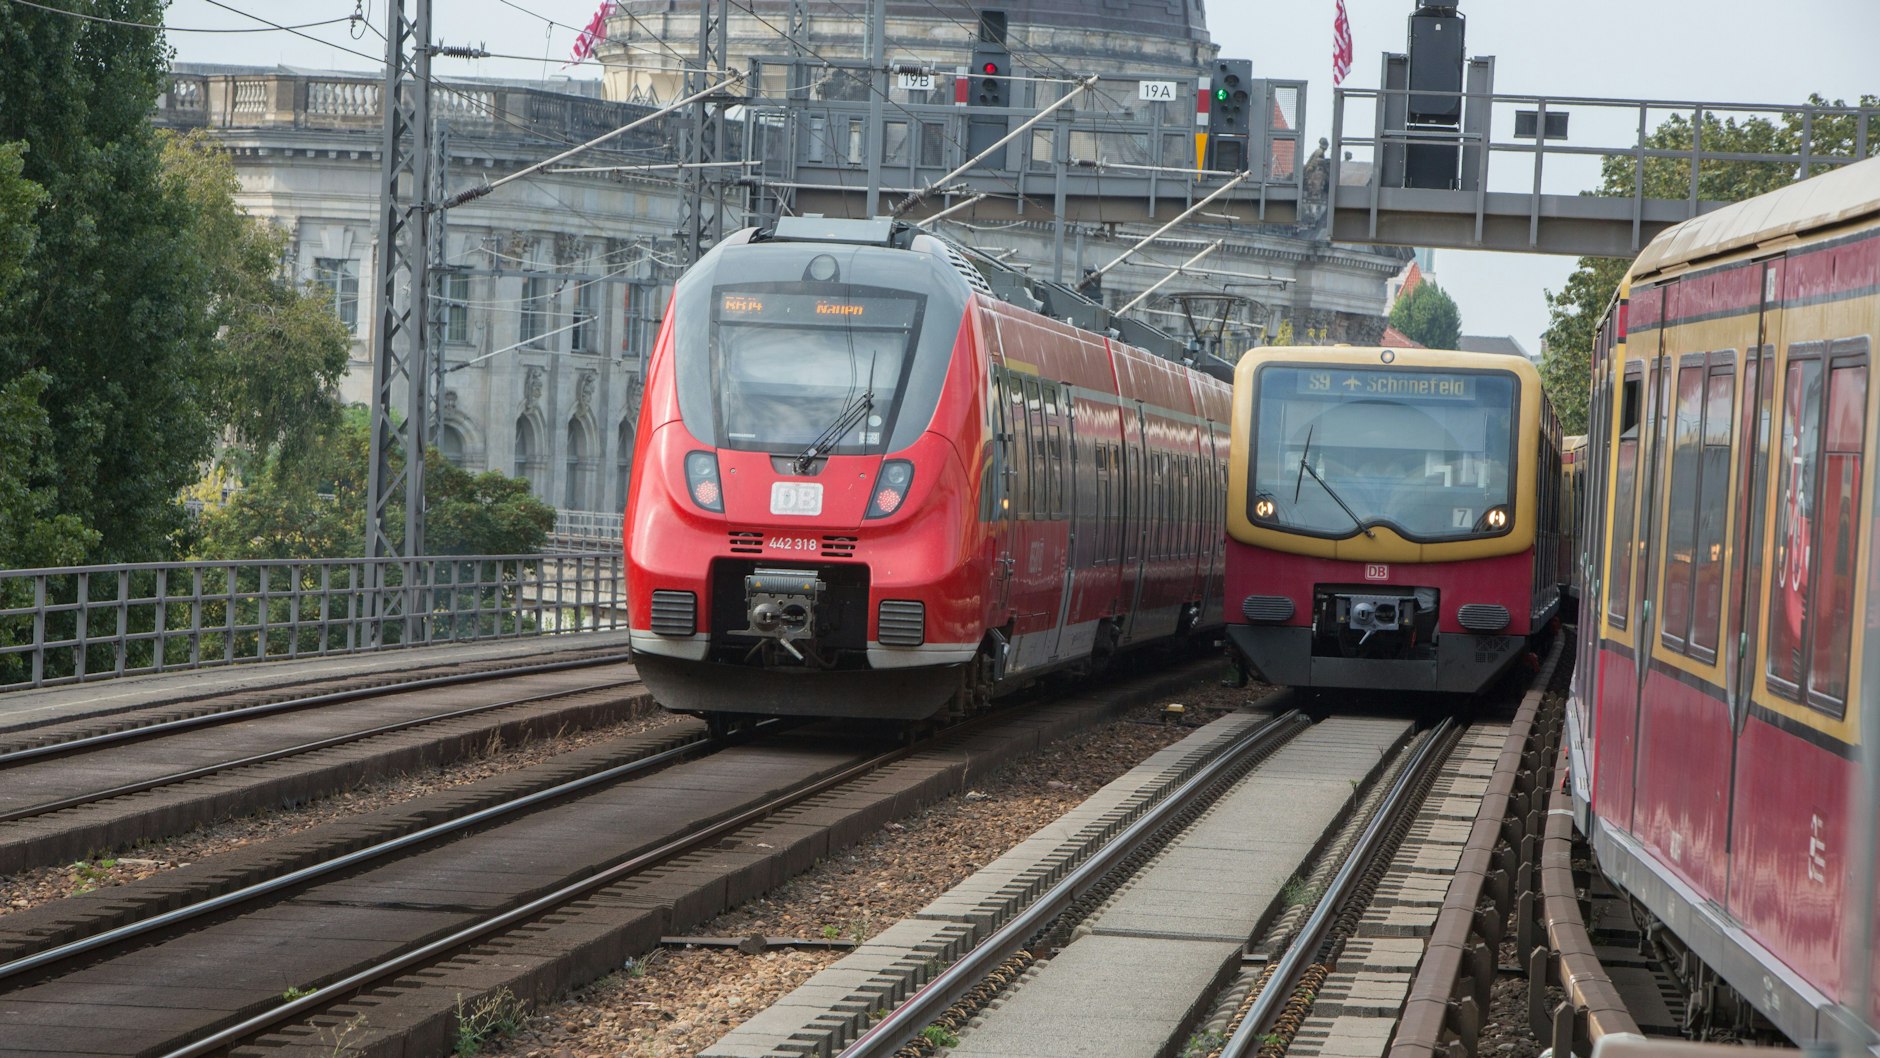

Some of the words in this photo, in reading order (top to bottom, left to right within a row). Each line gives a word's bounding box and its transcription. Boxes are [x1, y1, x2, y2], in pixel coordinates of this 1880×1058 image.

[905, 73, 929, 87] 19B
[1145, 84, 1171, 98] 19A
[1309, 372, 1331, 391] S9
[777, 486, 818, 510] DB
[1456, 509, 1468, 526] 7
[768, 536, 792, 550] 442
[794, 537, 817, 551] 318
[1368, 565, 1387, 578] DB
